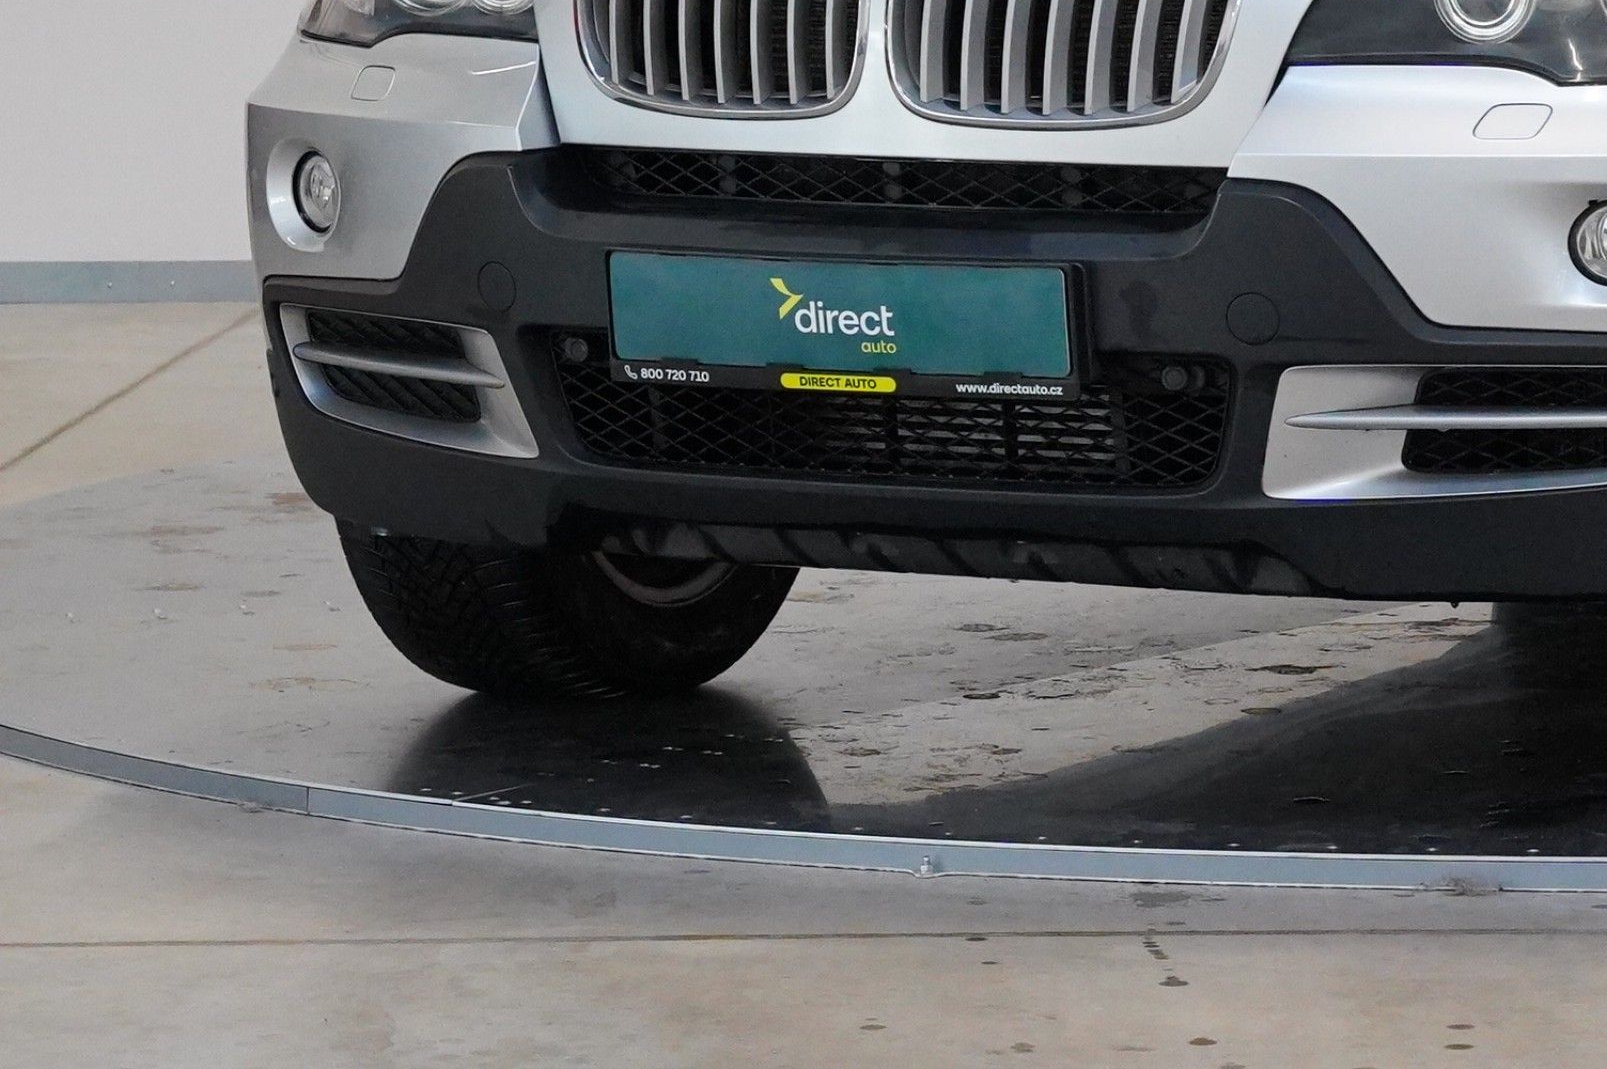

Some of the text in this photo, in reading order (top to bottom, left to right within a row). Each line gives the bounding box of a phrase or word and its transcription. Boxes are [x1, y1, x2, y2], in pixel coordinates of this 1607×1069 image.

[795, 301, 895, 336] direct
[861, 340, 897, 353] auto
[640, 368, 710, 382] 800 720 710
[800, 376, 877, 389] DIRECT AUTO
[956, 382, 1063, 395] www.directauto.cz
